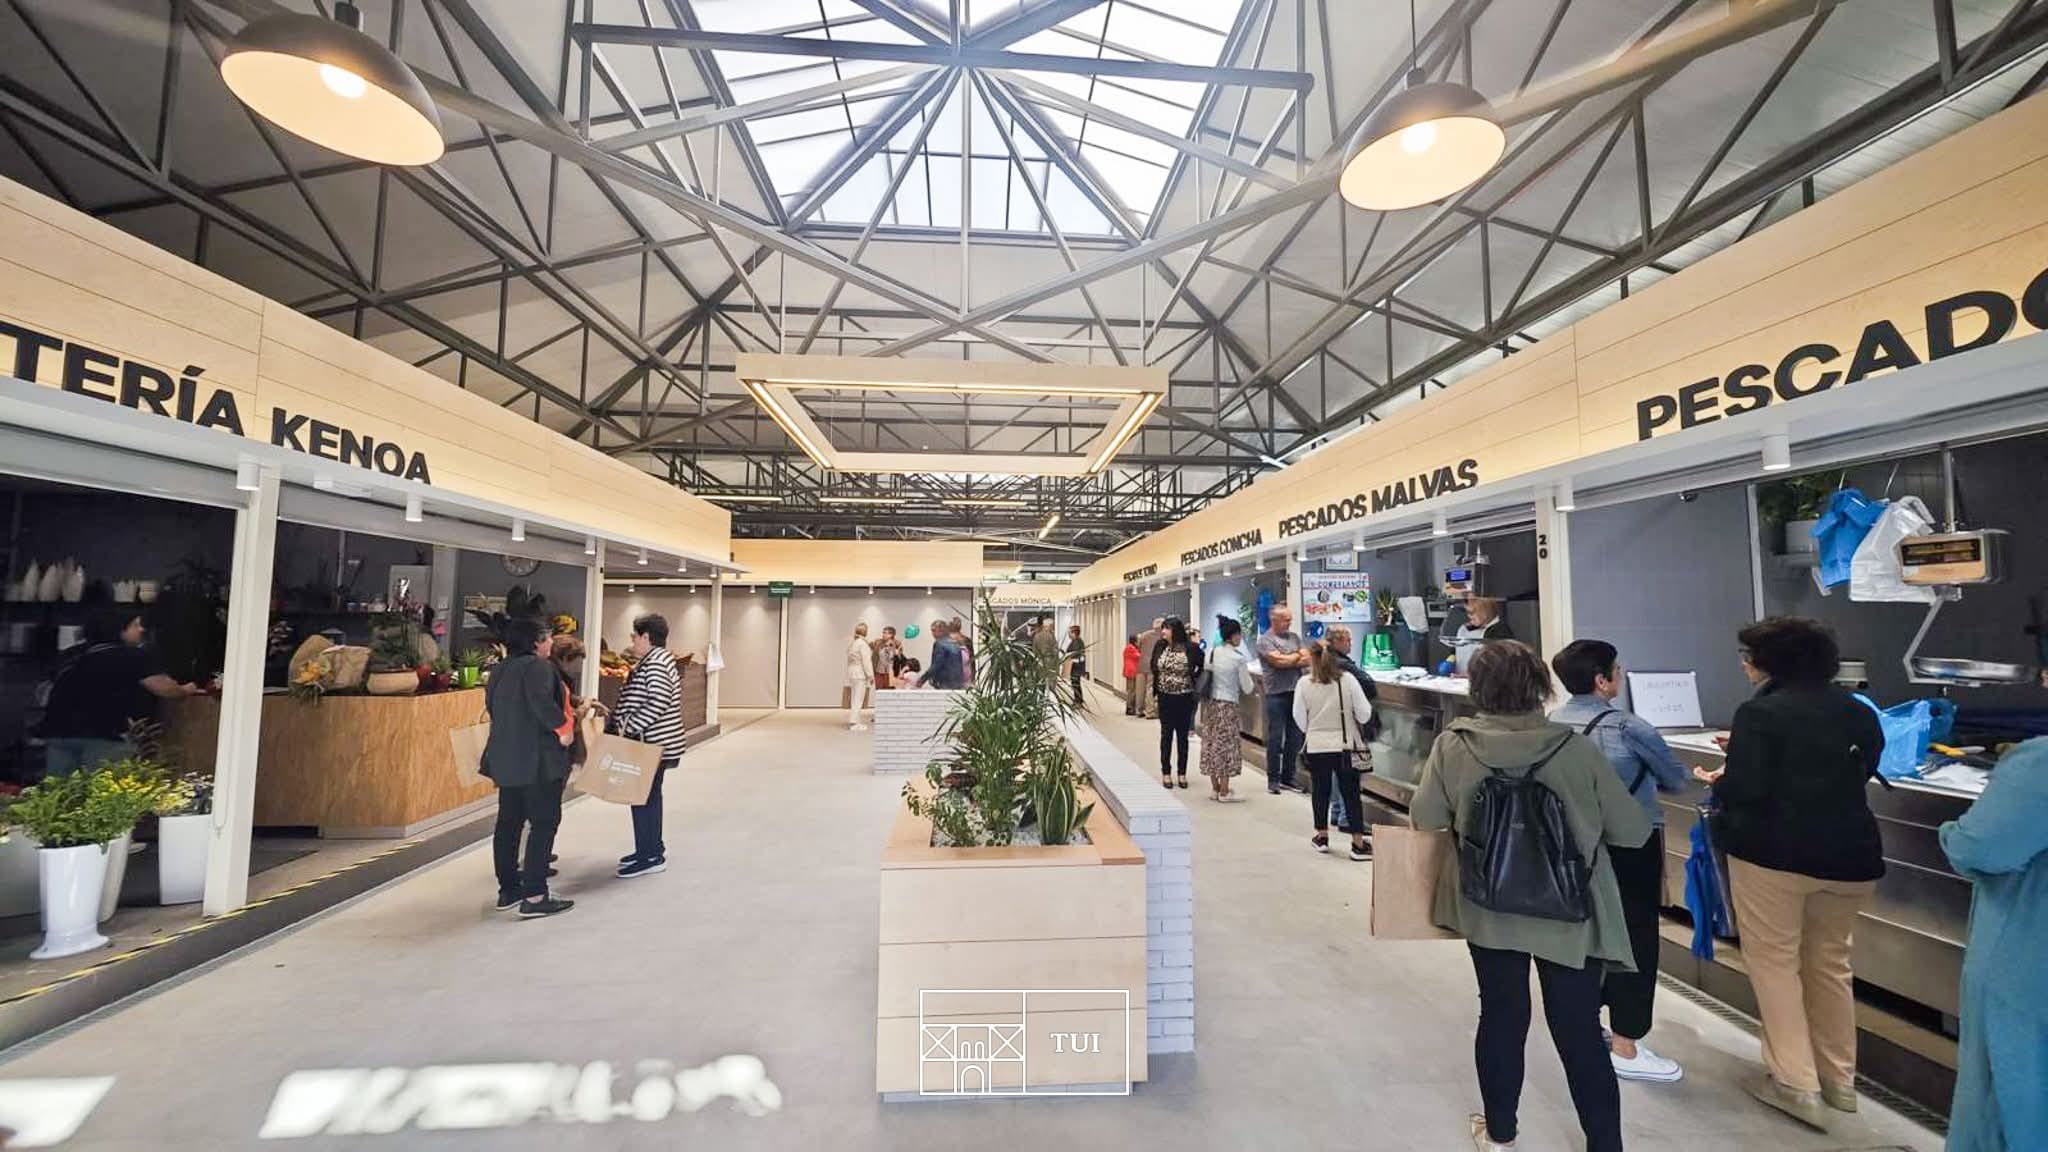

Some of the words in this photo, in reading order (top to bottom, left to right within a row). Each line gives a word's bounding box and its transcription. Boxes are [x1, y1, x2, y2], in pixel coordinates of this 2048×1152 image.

[0, 321, 245, 437] TERÍA
[271, 407, 432, 485] KENOA
[1637, 268, 2048, 441] PESCAD
[1181, 542, 1219, 567] PESCADOS
[1220, 528, 1263, 555] CONCHA
[1278, 493, 1367, 539] PESCADOS
[1371, 459, 1479, 514] MALVAS
